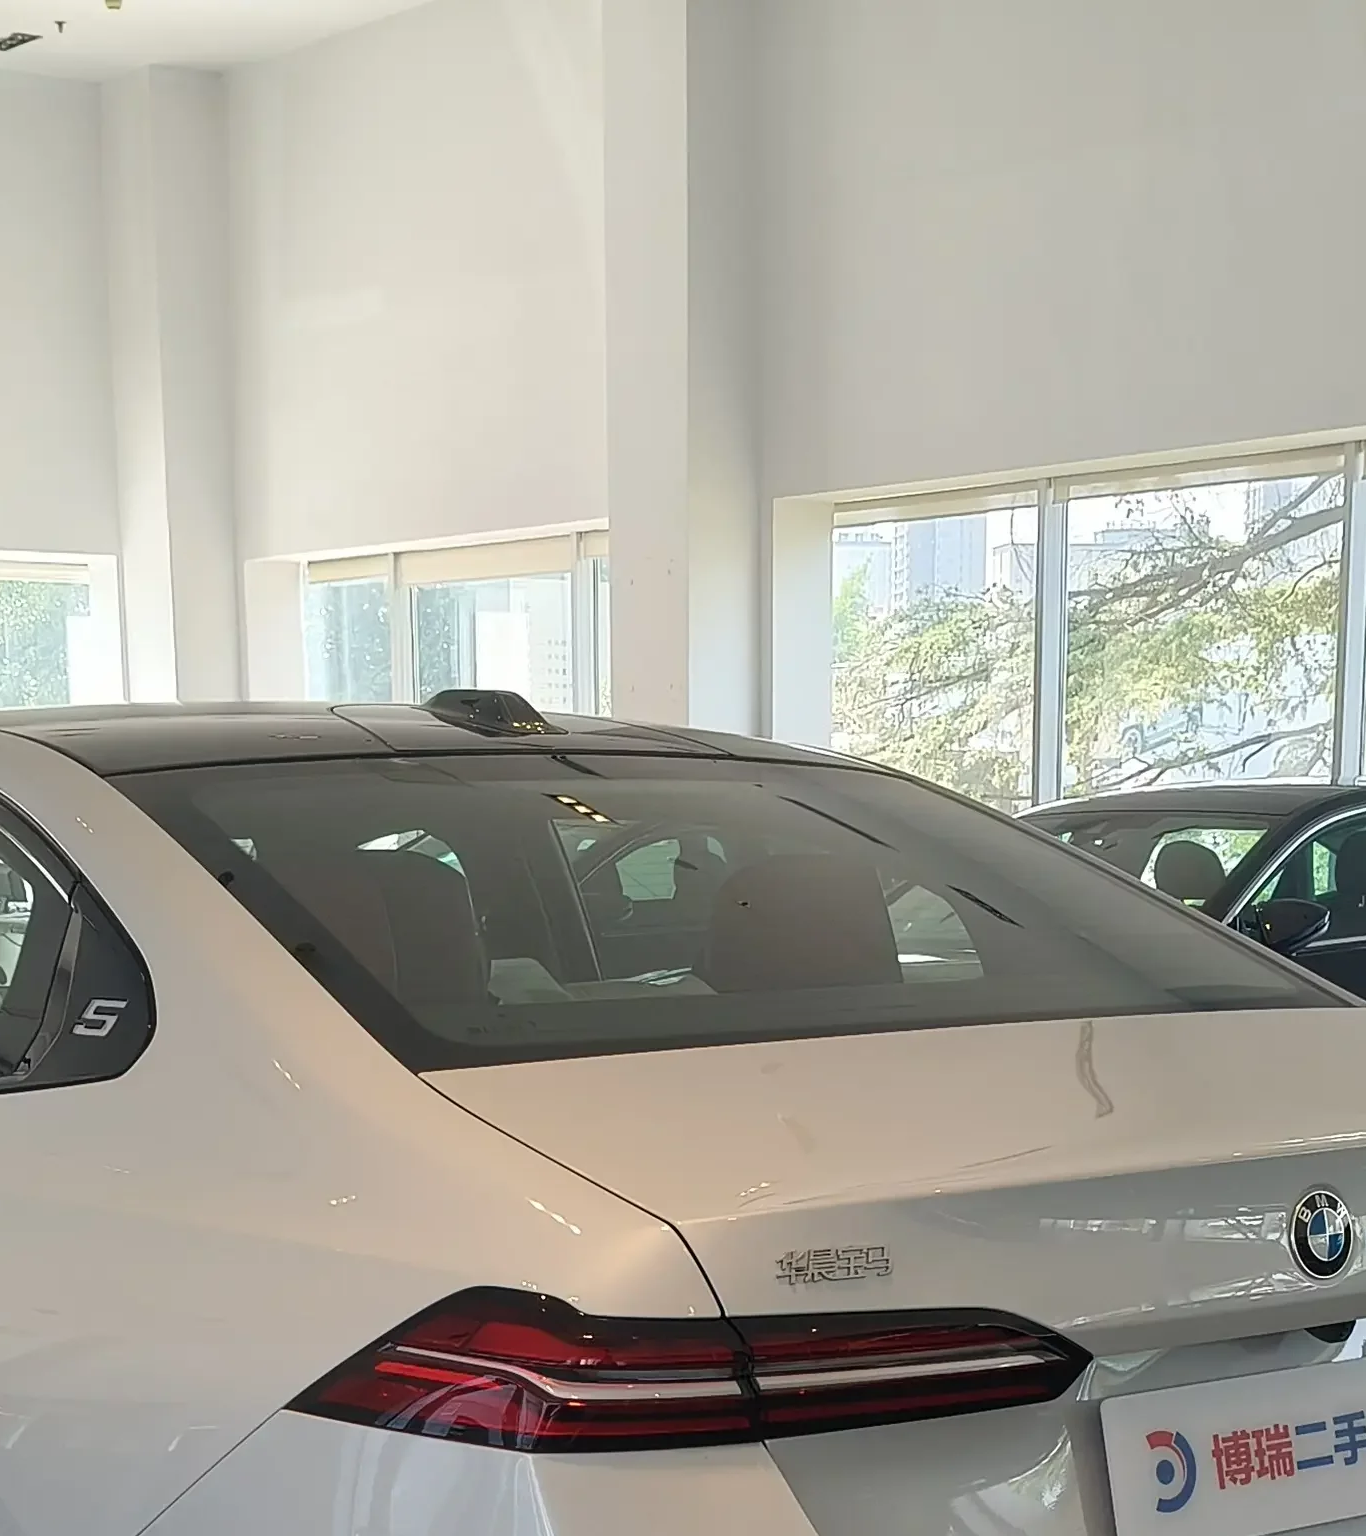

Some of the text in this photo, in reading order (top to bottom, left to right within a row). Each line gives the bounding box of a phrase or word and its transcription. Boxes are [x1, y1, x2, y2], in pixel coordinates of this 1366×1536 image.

[71, 997, 129, 1036] 5
[1297, 1193, 1350, 1227] BMW
[774, 1244, 895, 1286] 华晨宝马
